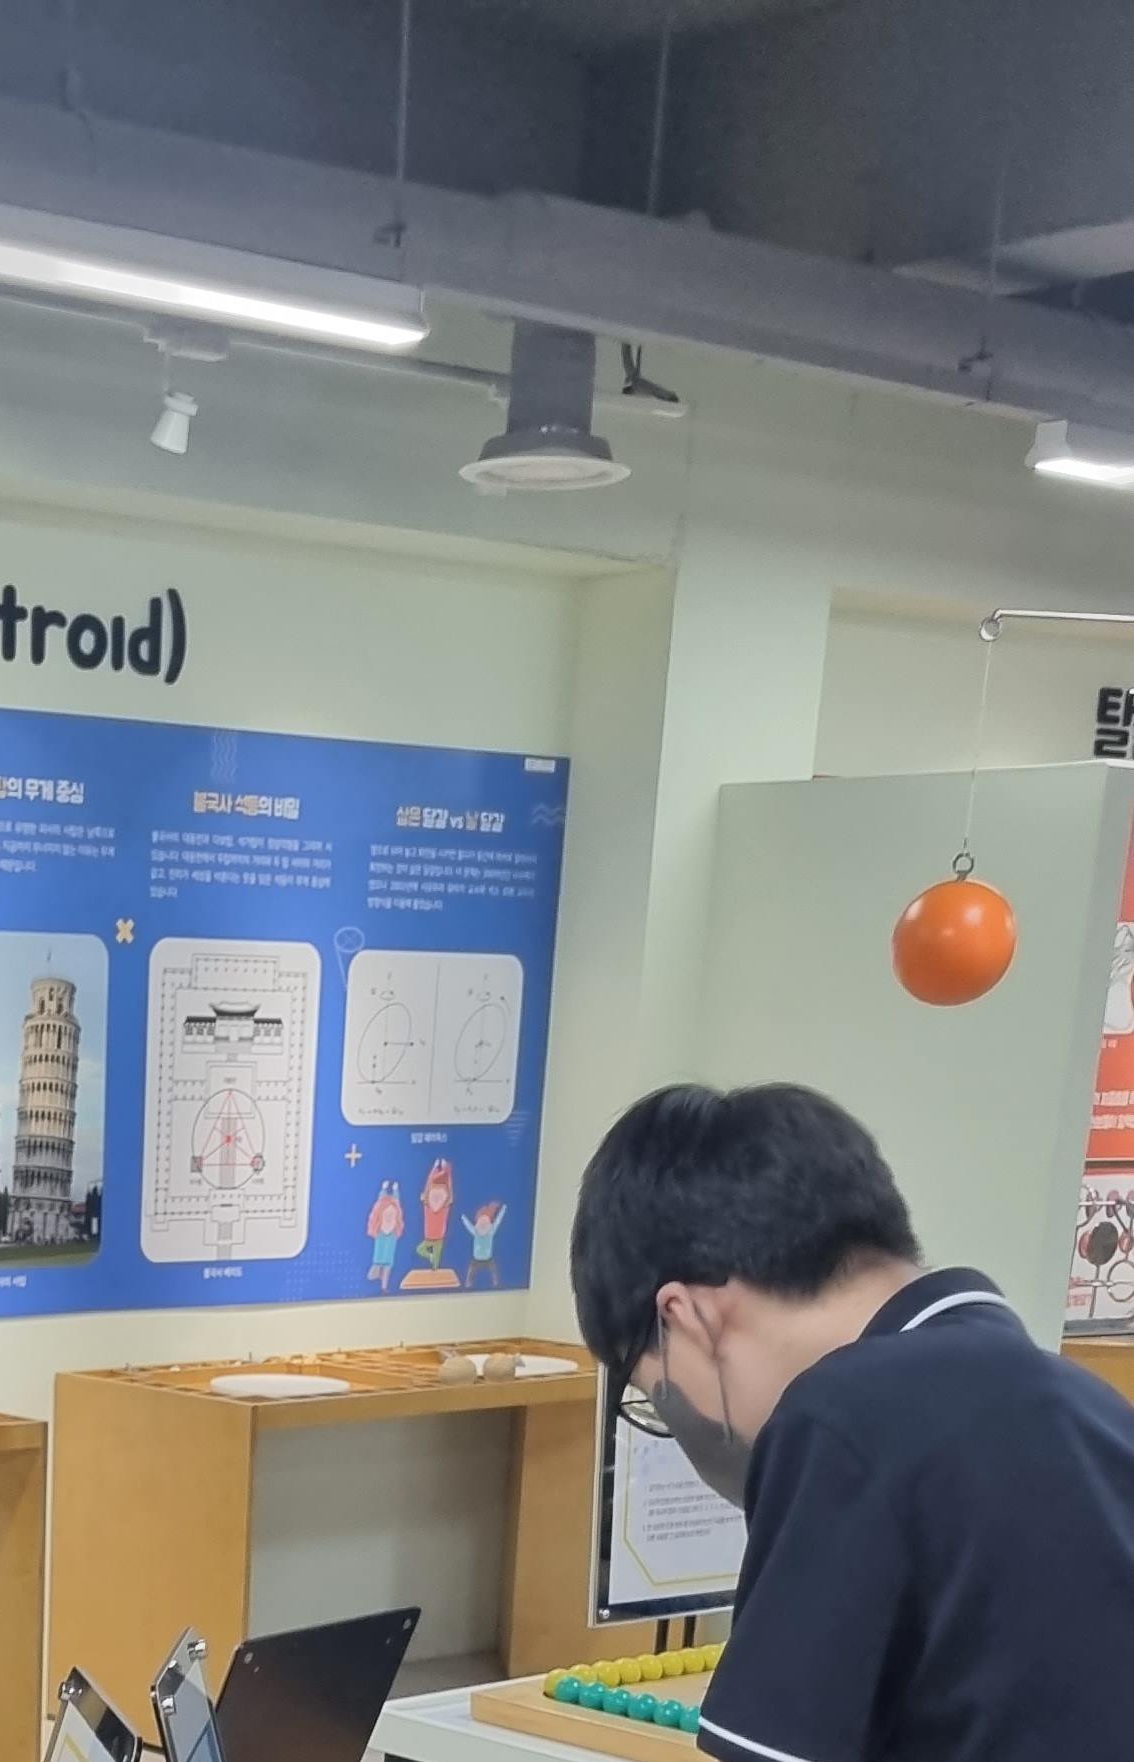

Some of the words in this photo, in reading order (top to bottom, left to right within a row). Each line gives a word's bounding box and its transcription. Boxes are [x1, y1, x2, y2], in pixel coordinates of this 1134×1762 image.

[24, 777, 54, 802] 무게
[56, 779, 84, 804] 중심
[193, 791, 233, 814] 불국사
[235, 794, 272, 818] 석등의
[274, 796, 300, 820] 비밀
[396, 805, 421, 827] 삶은
[423, 806, 449, 829] 달걀
[450, 815, 465, 830] vs
[480, 811, 505, 833] 달걀
